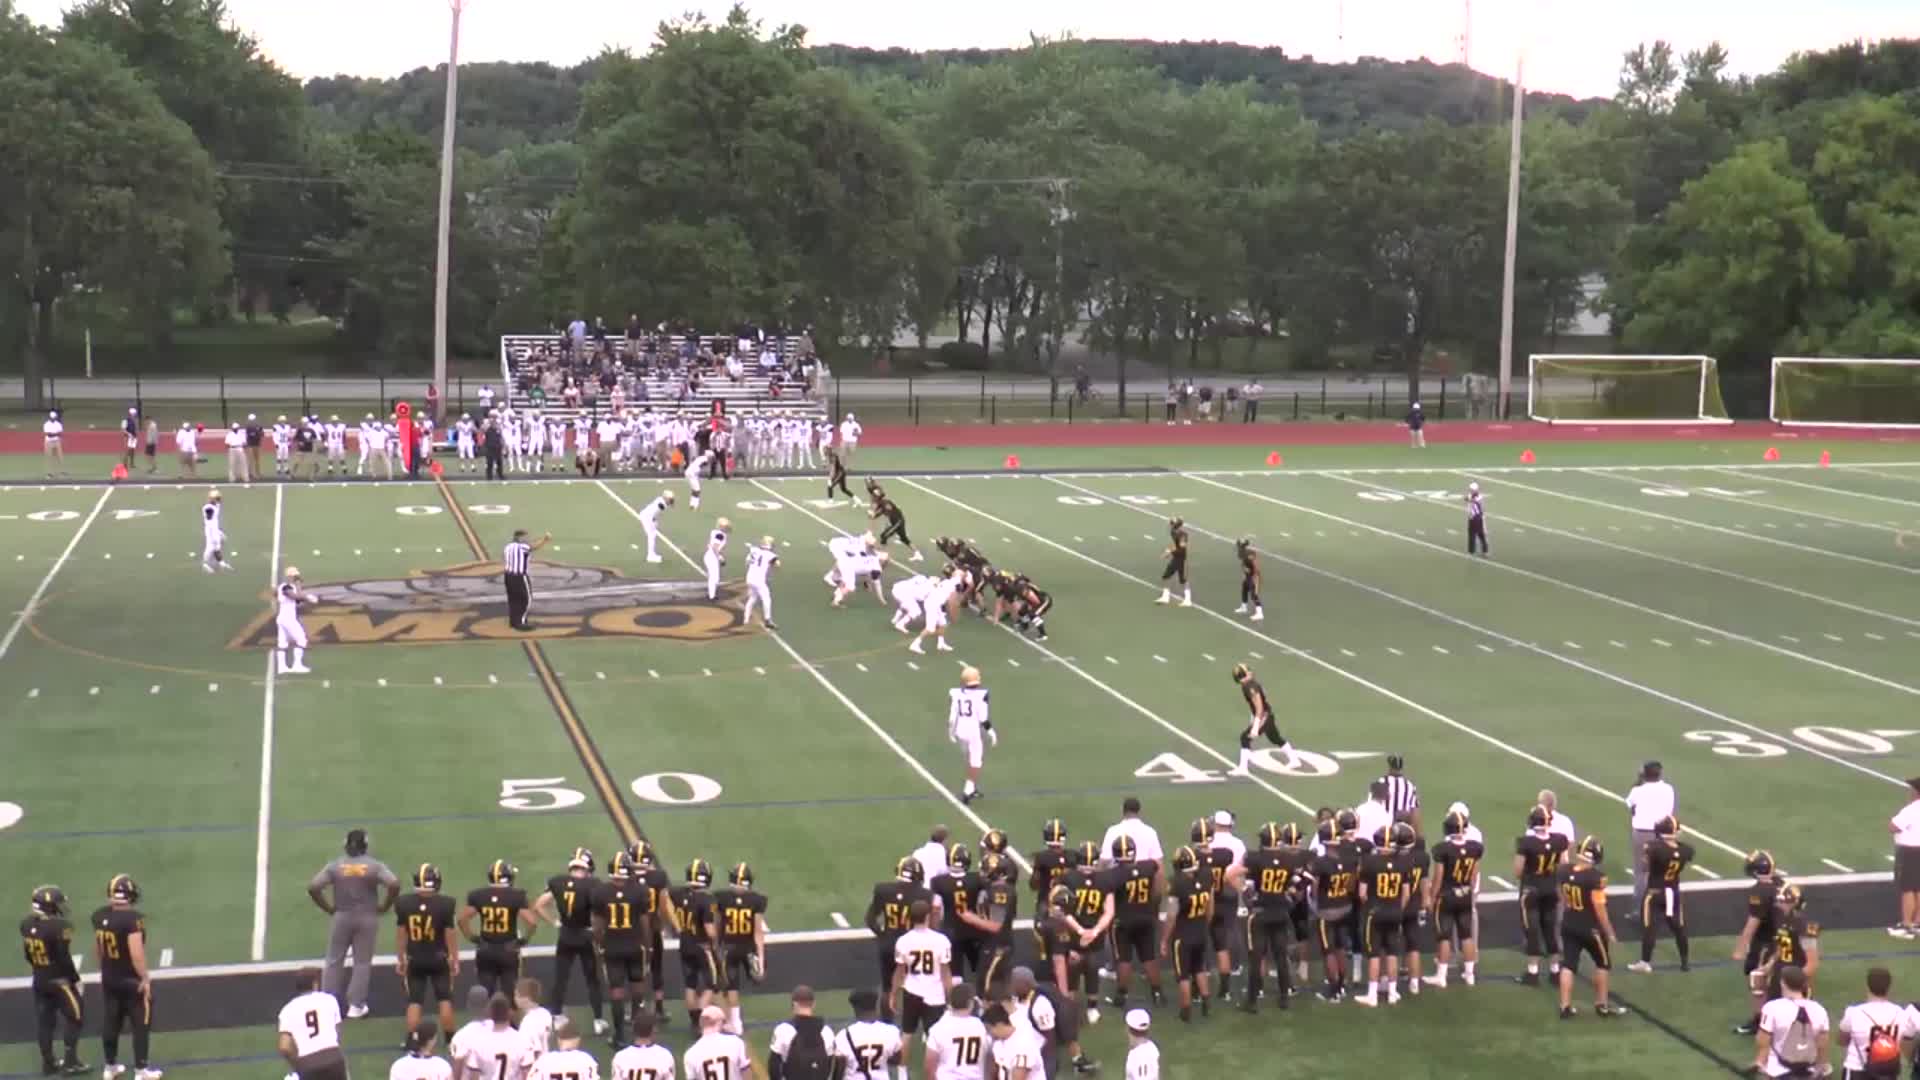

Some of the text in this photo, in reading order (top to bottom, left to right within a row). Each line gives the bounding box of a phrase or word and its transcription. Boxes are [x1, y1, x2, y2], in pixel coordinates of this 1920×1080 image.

[957, 699, 973, 717] 13
[1683, 726, 1894, 757] 30
[1134, 748, 1340, 783] 40
[500, 772, 722, 810] 50
[1452, 857, 1474, 882] 47
[1535, 853, 1558, 876] 14
[1665, 861, 1680, 881] 2
[1125, 879, 1149, 904] 75
[1260, 868, 1288, 893] 82
[1376, 872, 1401, 897] 83
[563, 891, 576, 917] 7
[1075, 889, 1100, 915] 79
[408, 914, 435, 942] 64
[481, 906, 509, 933] 23
[607, 902, 632, 929] 11
[725, 908, 752, 934] 36
[909, 950, 934, 975] 28
[305, 1009, 319, 1039] 9
[952, 1036, 981, 1066] 70
[495, 1053, 507, 1080] 7
[702, 1056, 729, 1080] 67
